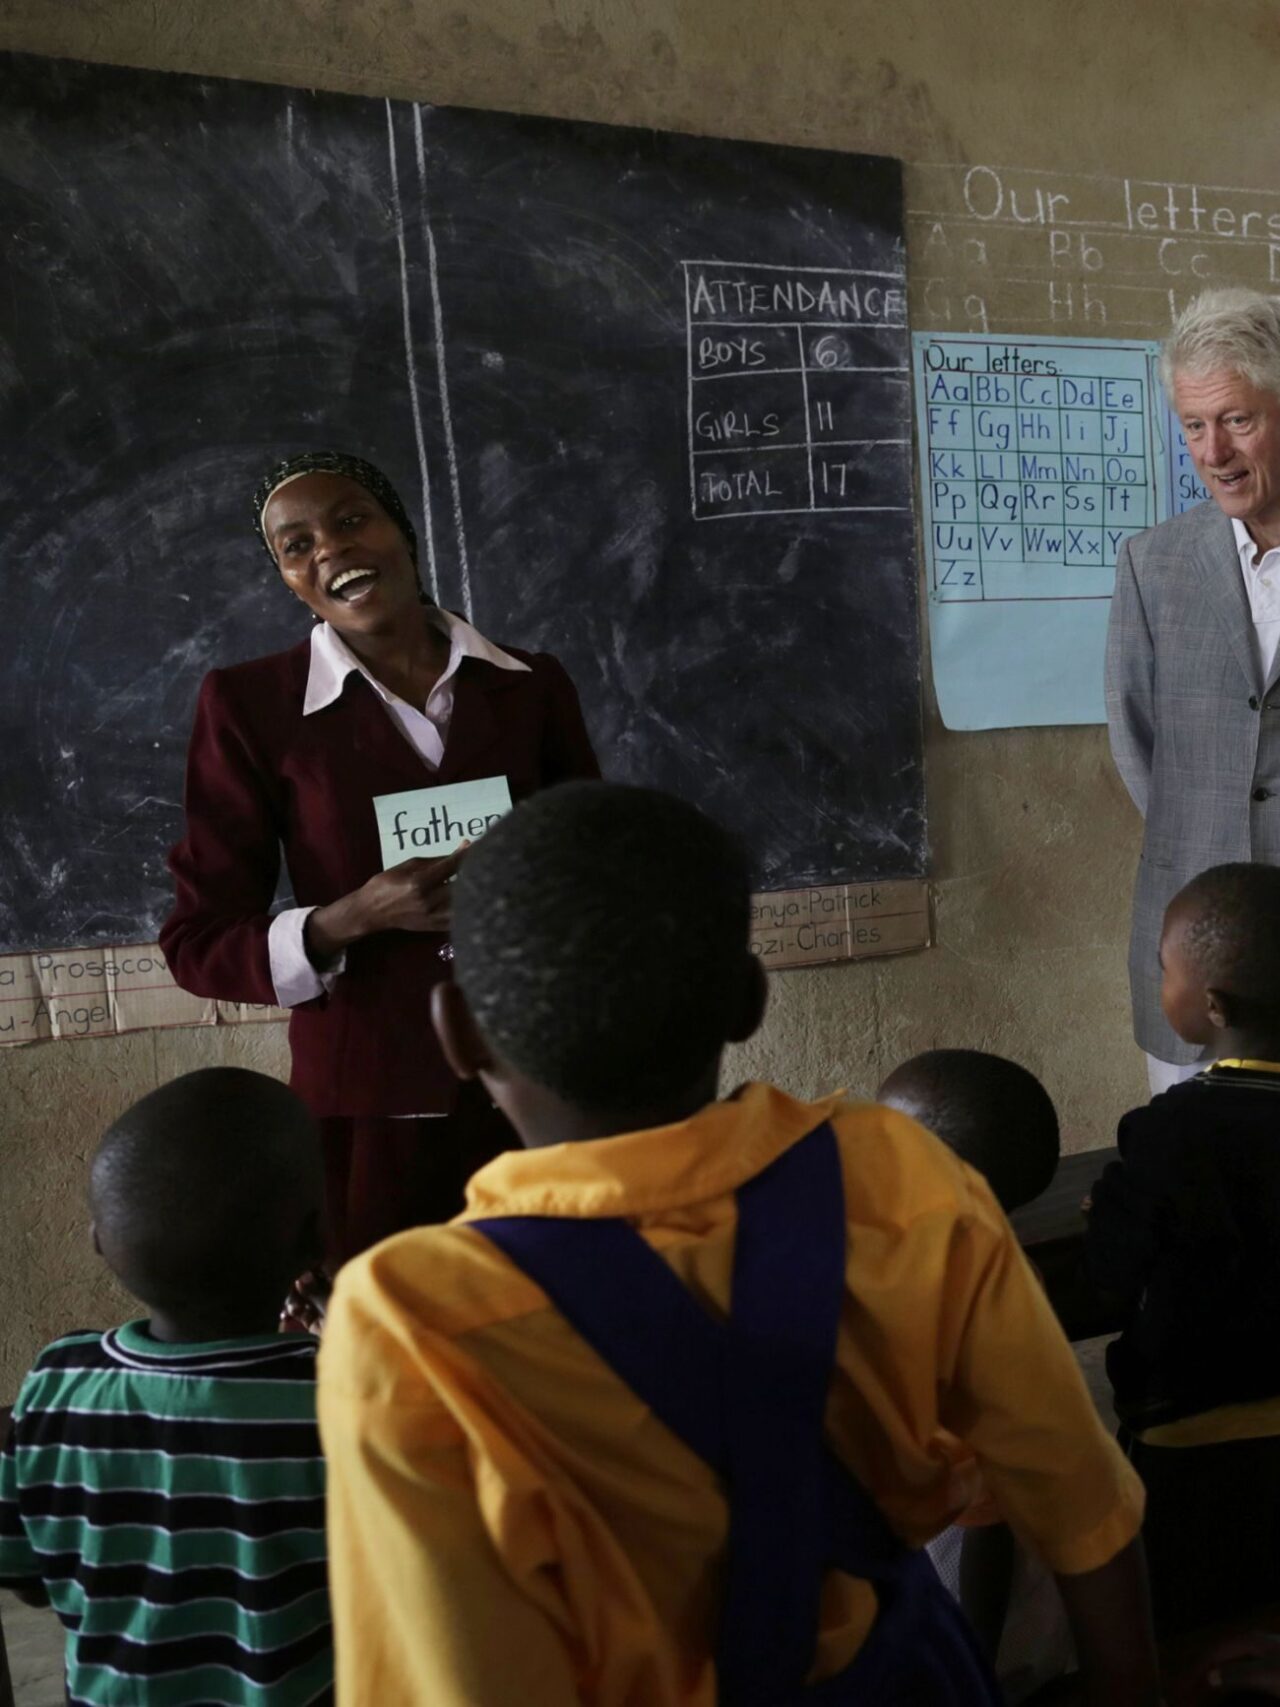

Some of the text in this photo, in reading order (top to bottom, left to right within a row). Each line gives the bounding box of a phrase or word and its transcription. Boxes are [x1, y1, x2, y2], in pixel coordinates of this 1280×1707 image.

[963, 165, 1070, 225] Our
[693, 274, 902, 320] ATTENDANCE
[699, 335, 838, 370] BOYS 6
[926, 344, 974, 372] Our
[931, 373, 1134, 409] Aa Bb Cc Dd Ee
[695, 401, 834, 442] GIRLS 11
[929, 407, 960, 436] Ff
[978, 409, 1010, 450] Gg
[1020, 412, 1051, 440] Hh
[1104, 415, 1129, 454] Jj
[700, 461, 847, 503] TOTAL 17
[931, 452, 965, 479] Kk
[1021, 455, 1058, 480] Mm
[1065, 456, 1095, 481] Nn
[1106, 458, 1137, 483] Oo
[934, 481, 1131, 521] Pp Qq Rr Ss Tt
[936, 525, 1123, 555] Uu Vv Ww Xx Y
[940, 559, 976, 586] Zz
[751, 887, 882, 928] enya-Patrick
